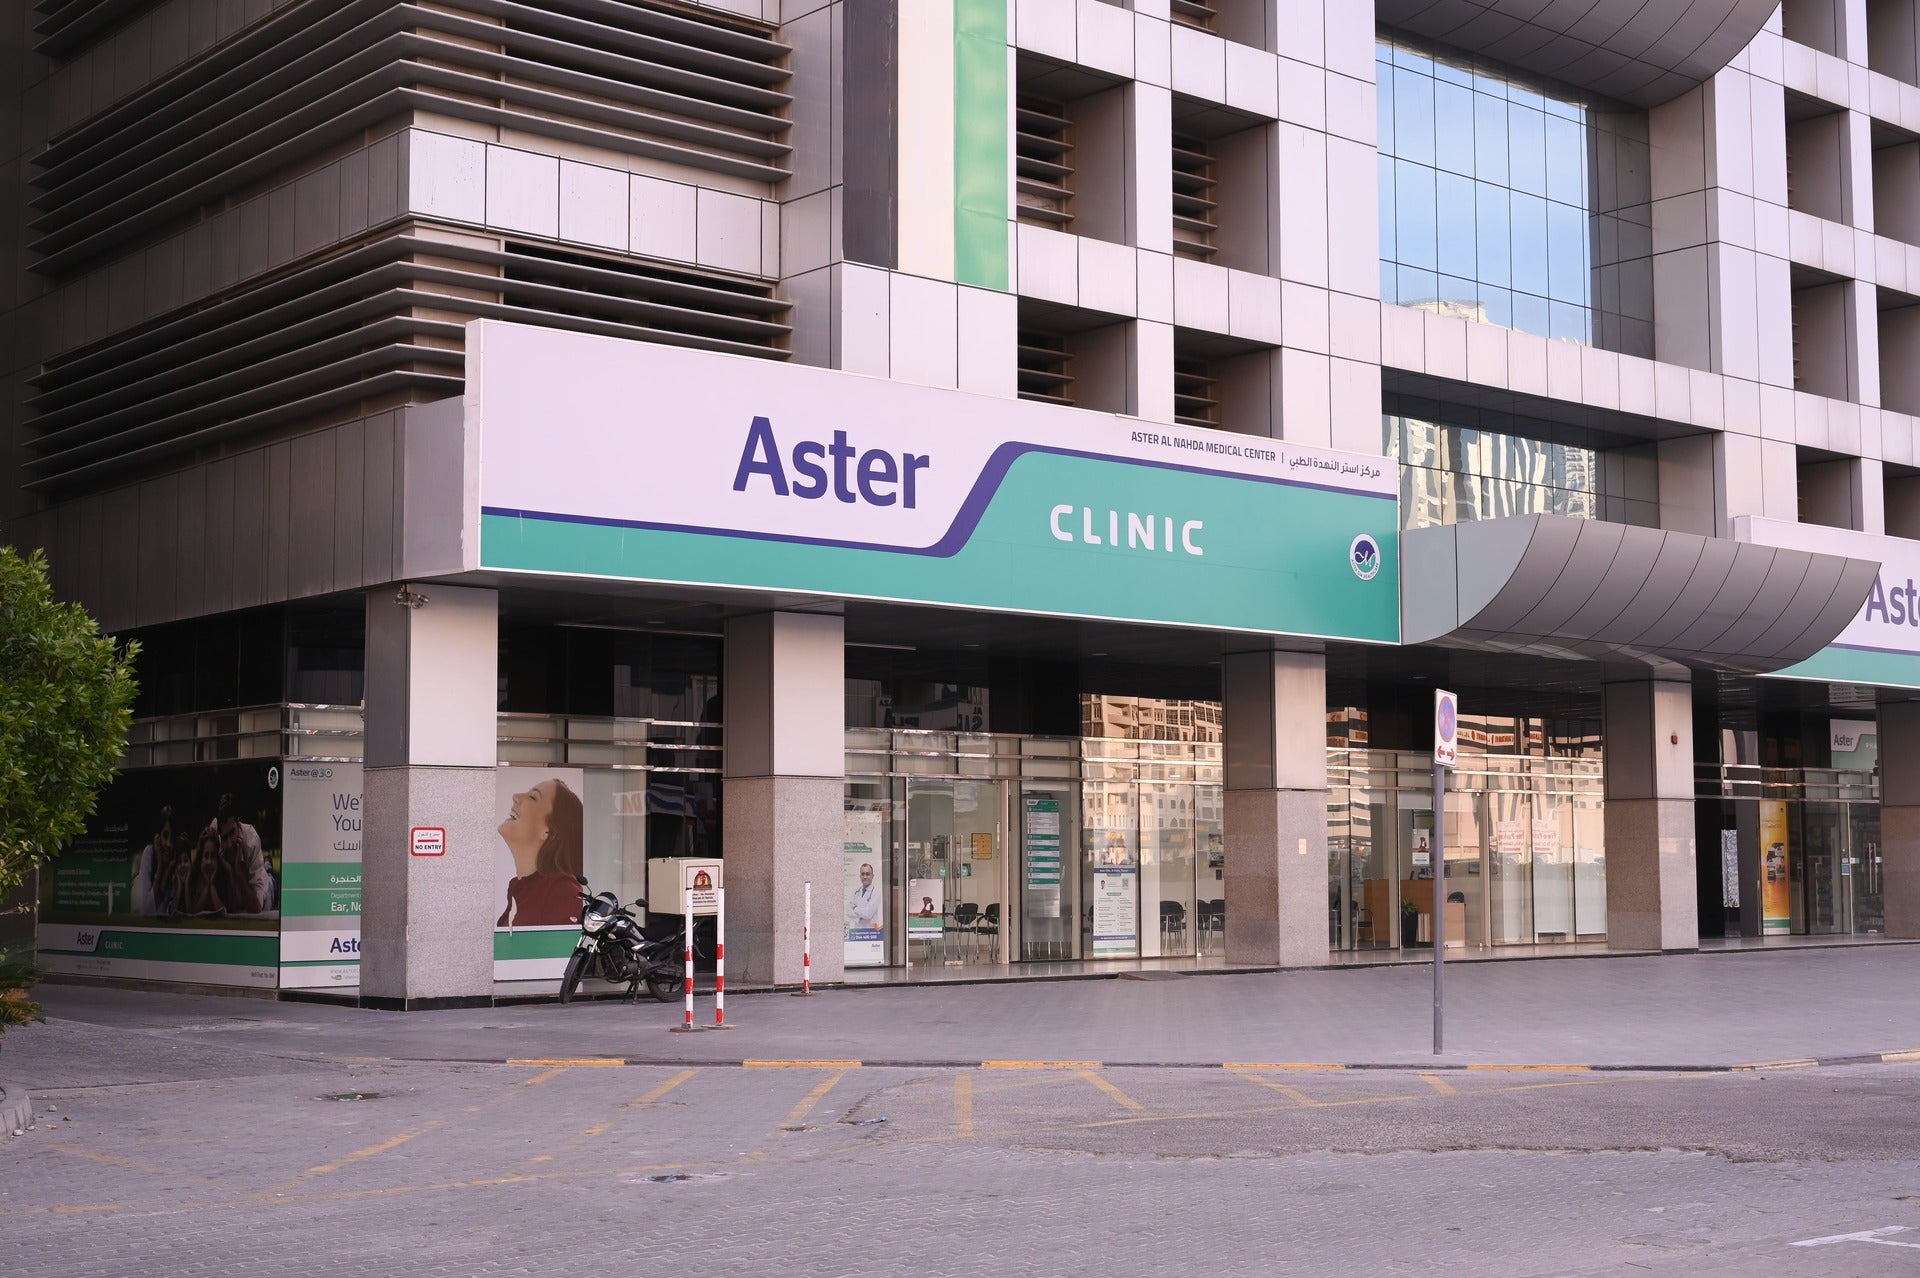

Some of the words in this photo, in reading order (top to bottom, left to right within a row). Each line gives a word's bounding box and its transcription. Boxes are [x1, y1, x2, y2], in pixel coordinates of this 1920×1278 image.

[1131, 431, 1160, 445] ASTER
[1161, 436, 1172, 447] AL
[1173, 437, 1204, 451] NAHDA
[1205, 442, 1242, 457] MEDICAL
[1244, 448, 1276, 462] CENTER
[733, 415, 930, 509] Aster
[1289, 455, 1312, 470] الطبي
[1313, 457, 1340, 471] النهدة
[1360, 464, 1381, 478] مركز
[1050, 504, 1204, 556] CLINIC
[1865, 573, 1920, 627] Ast
[1833, 734, 1853, 747] Aster
[332, 814, 362, 832] You
[331, 901, 349, 912] Ear,
[77, 931, 94, 946] Aster
[105, 941, 124, 950] CLINIC
